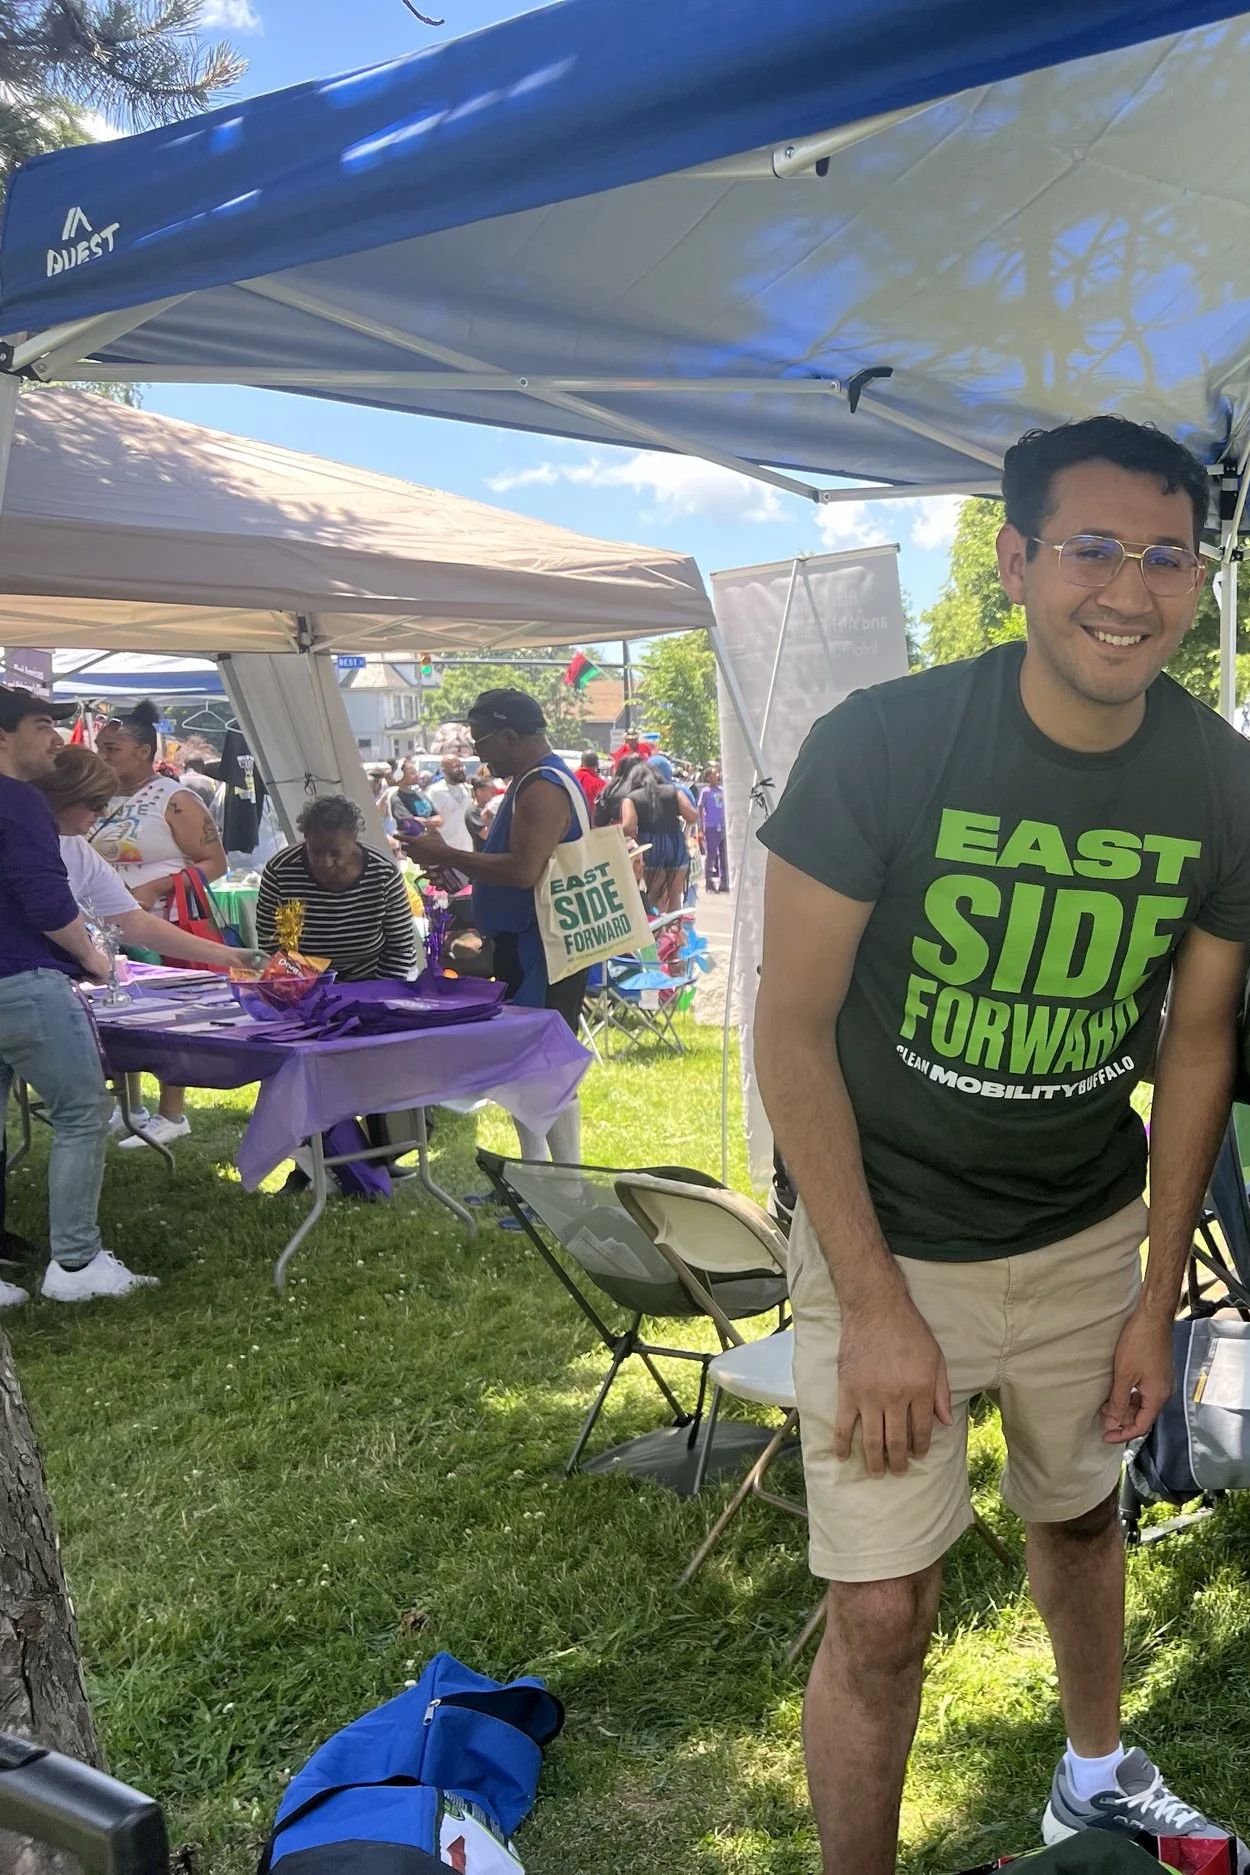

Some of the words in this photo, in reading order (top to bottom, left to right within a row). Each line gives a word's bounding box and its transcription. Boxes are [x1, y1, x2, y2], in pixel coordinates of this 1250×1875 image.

[935, 808, 1201, 885] EAST
[550, 861, 610, 895] EAST
[554, 878, 624, 931] SIDE
[563, 913, 632, 955] FORWARD
[911, 874, 1189, 1001] SIDE
[928, 1063, 1081, 1100] MOBILITY
[1076, 1055, 1136, 1096] BUFFALO
